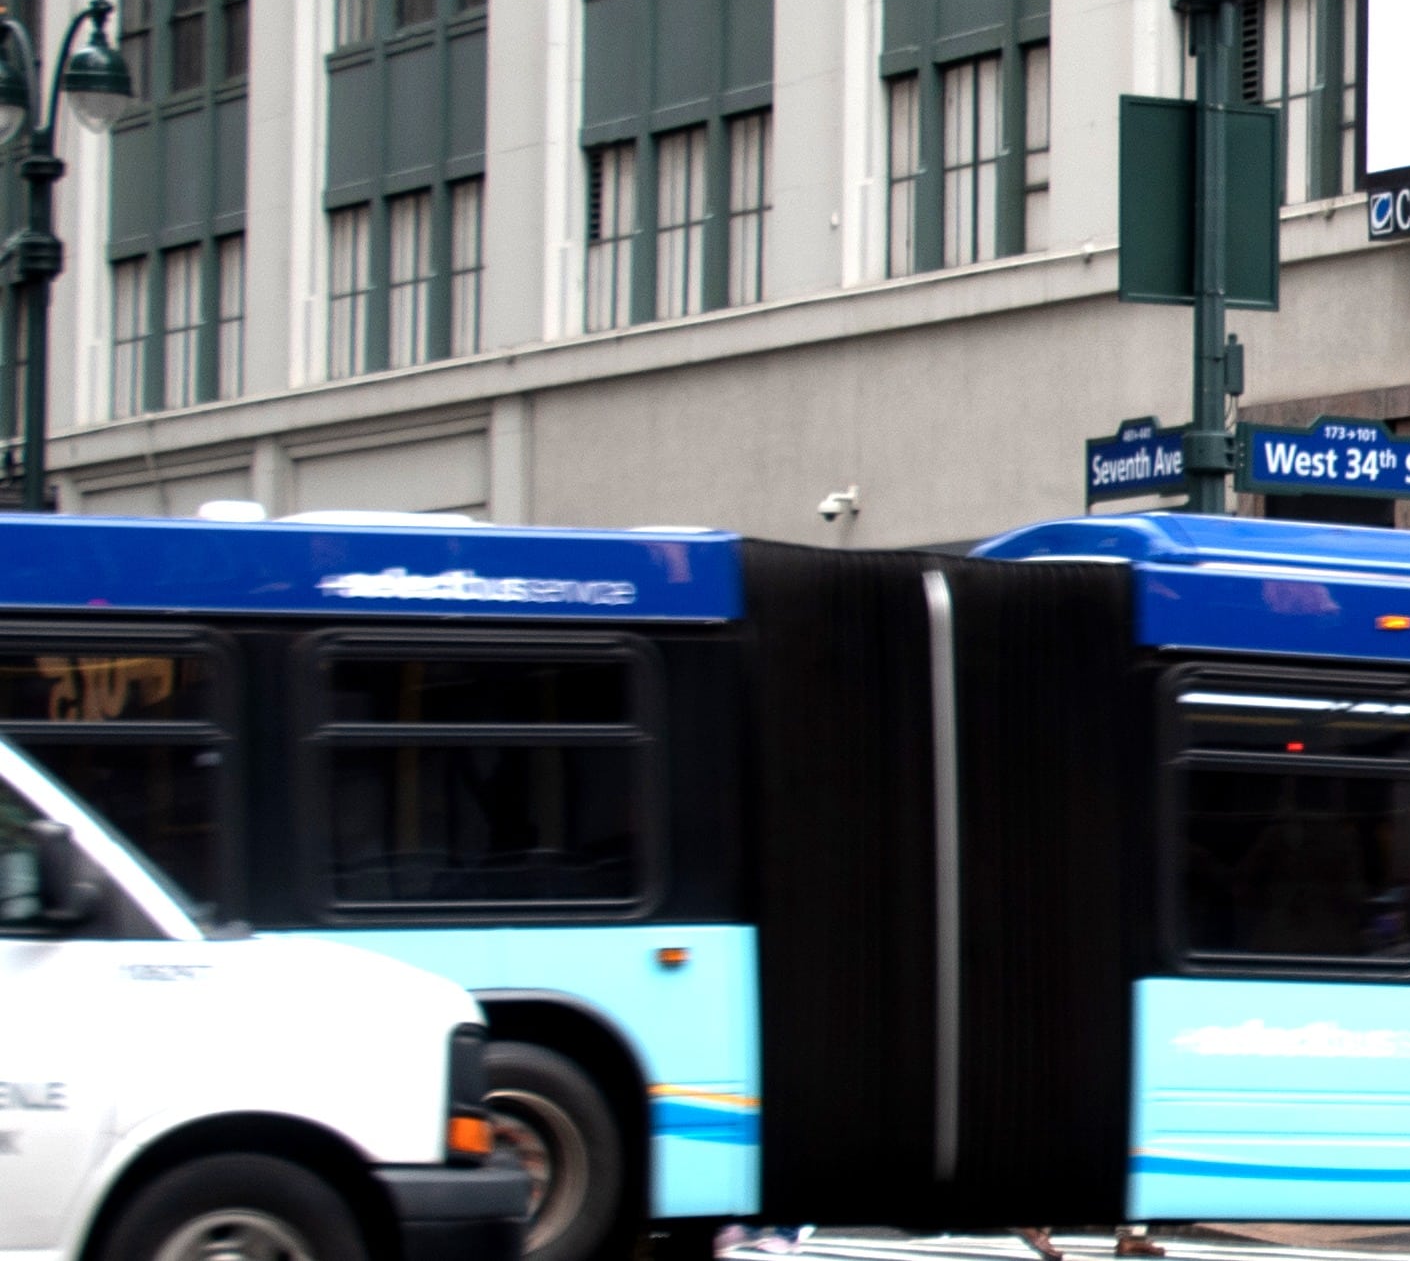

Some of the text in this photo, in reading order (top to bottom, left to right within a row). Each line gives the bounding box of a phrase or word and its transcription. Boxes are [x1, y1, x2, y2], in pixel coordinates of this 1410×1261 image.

[1092, 446, 1184, 486] Seventh Ave
[1264, 442, 1338, 479] West
[1345, 448, 1398, 481] 34th
